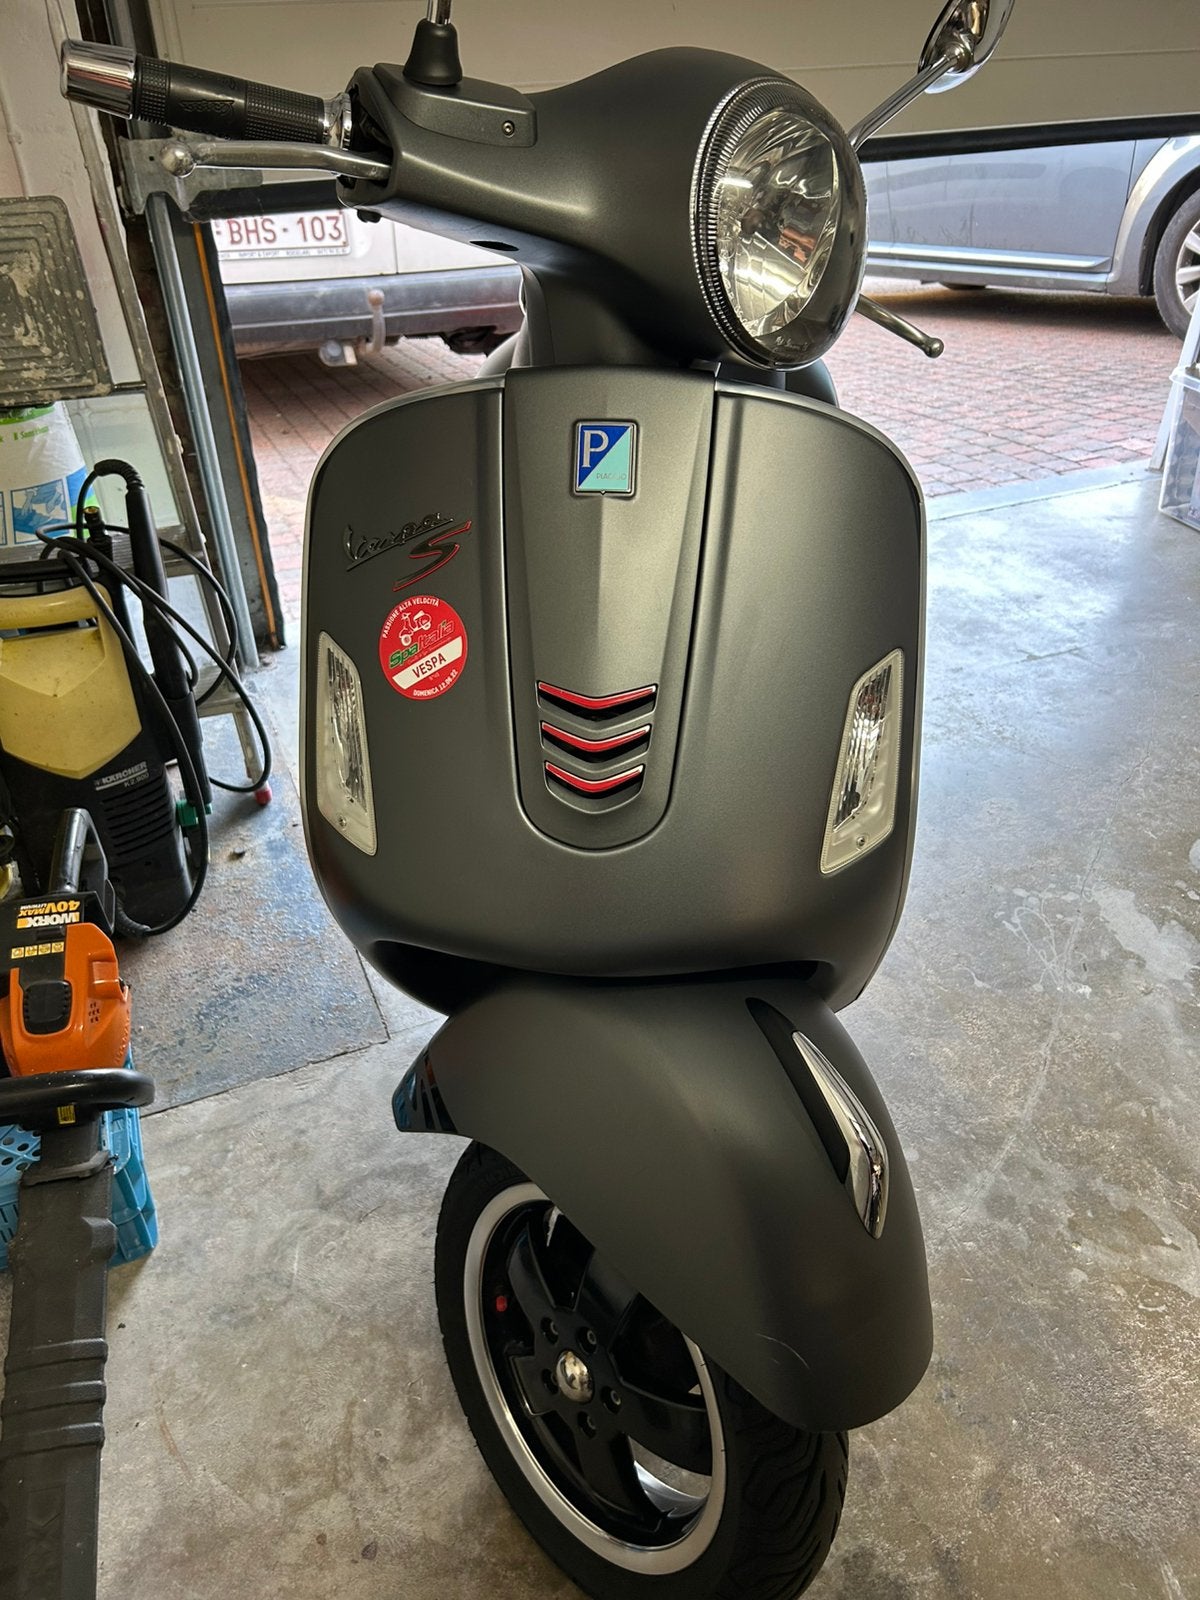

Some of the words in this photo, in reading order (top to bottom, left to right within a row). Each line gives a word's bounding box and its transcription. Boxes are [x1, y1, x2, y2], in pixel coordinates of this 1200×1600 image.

[227, 217, 277, 245] BHS
[296, 216, 342, 242] 103
[582, 430, 609, 468] P
[382, 610, 400, 639] PASSIONE
[399, 601, 412, 613] ALTA
[412, 653, 447, 678] VESPA
[412, 687, 439, 697] DOMENICA
[18, 907, 46, 917] MAX
[45, 900, 81, 914] 40V
[26, 912, 79, 928] WORX
